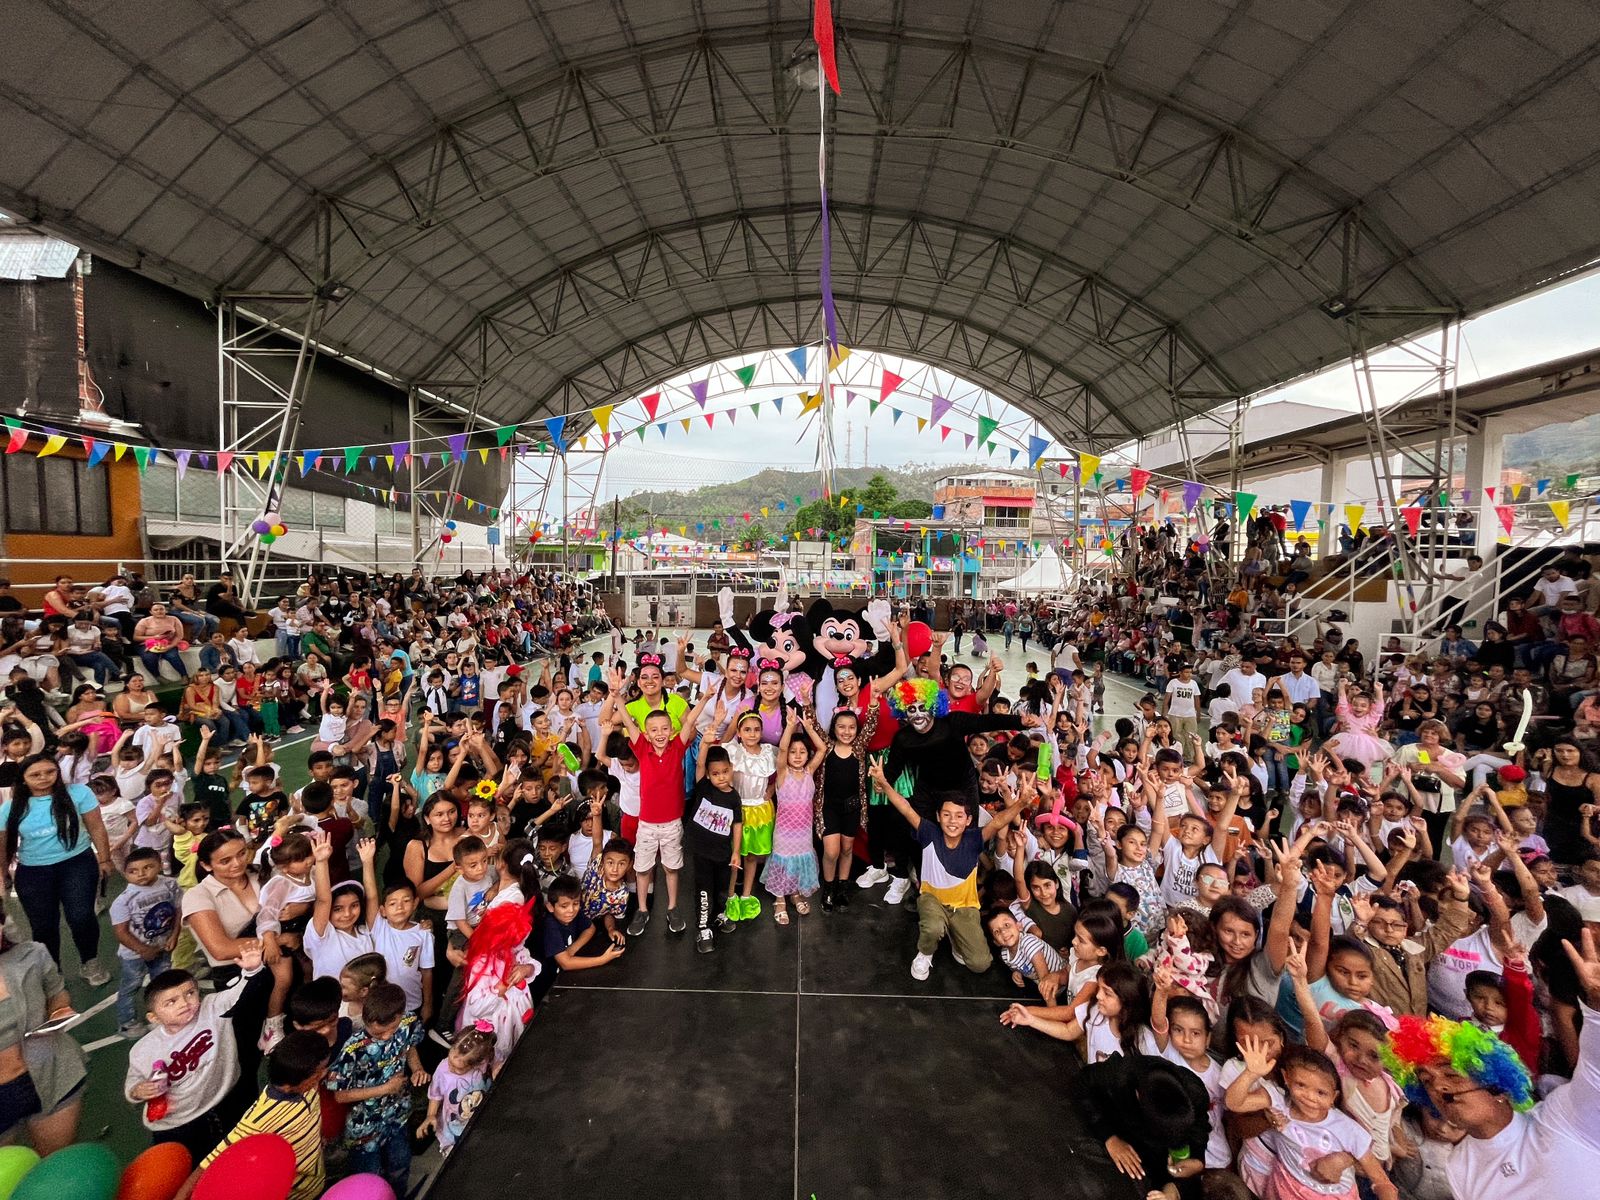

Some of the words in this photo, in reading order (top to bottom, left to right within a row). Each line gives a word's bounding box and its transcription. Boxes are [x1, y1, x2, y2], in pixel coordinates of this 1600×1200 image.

[1176, 690, 1193, 699] SUN
[1173, 882, 1197, 896] STOP
[1451, 958, 1479, 971] YORK
